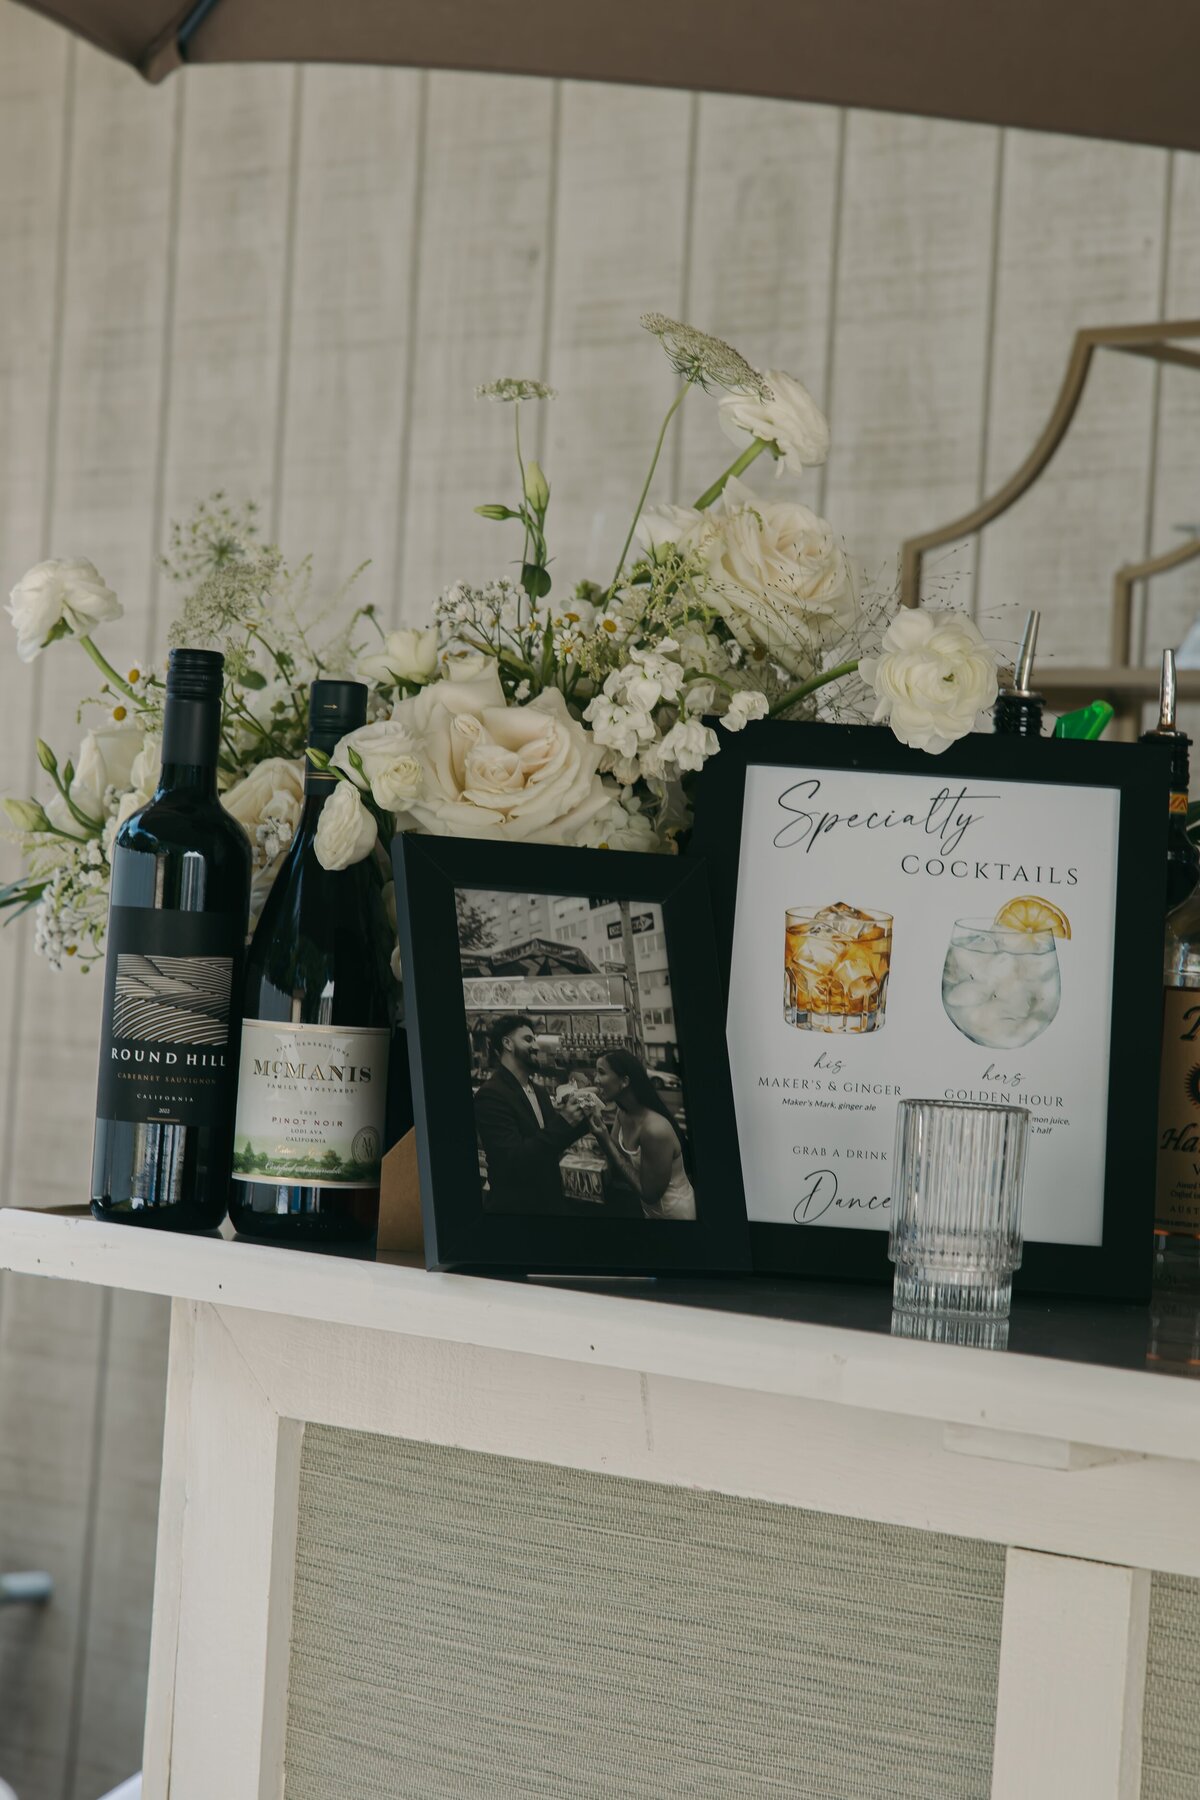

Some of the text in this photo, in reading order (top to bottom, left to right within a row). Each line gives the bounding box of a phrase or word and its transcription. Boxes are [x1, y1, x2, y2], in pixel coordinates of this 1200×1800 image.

[773, 779, 1001, 856] Specialty
[900, 854, 1080, 886] COCKTAILS
[111, 1047, 226, 1067] ROUND HILL
[813, 1051, 846, 1074] his
[117, 1071, 217, 1085] CABERNET SAUVIGNON
[982, 1063, 1026, 1087] hers
[267, 1083, 298, 1091] FAMILY
[757, 1076, 902, 1096] MAKER'S & GINGER
[136, 1092, 194, 1102] CALIFORNIA
[781, 1097, 877, 1112] Maker's Mark, ginger ale
[944, 1088, 1064, 1107] GOLDEN HOUR
[271, 1116, 344, 1128] PINOT NOIR
[1031, 1116, 1071, 1126] mon juice,
[1036, 1126, 1053, 1135] half
[1160, 1122, 1200, 1152] Ha
[285, 1136, 327, 1144] CALIFORNIA
[792, 1145, 888, 1160] GRAB A DRINK
[793, 1169, 892, 1224] Dance
[1170, 1205, 1200, 1215] AUST
